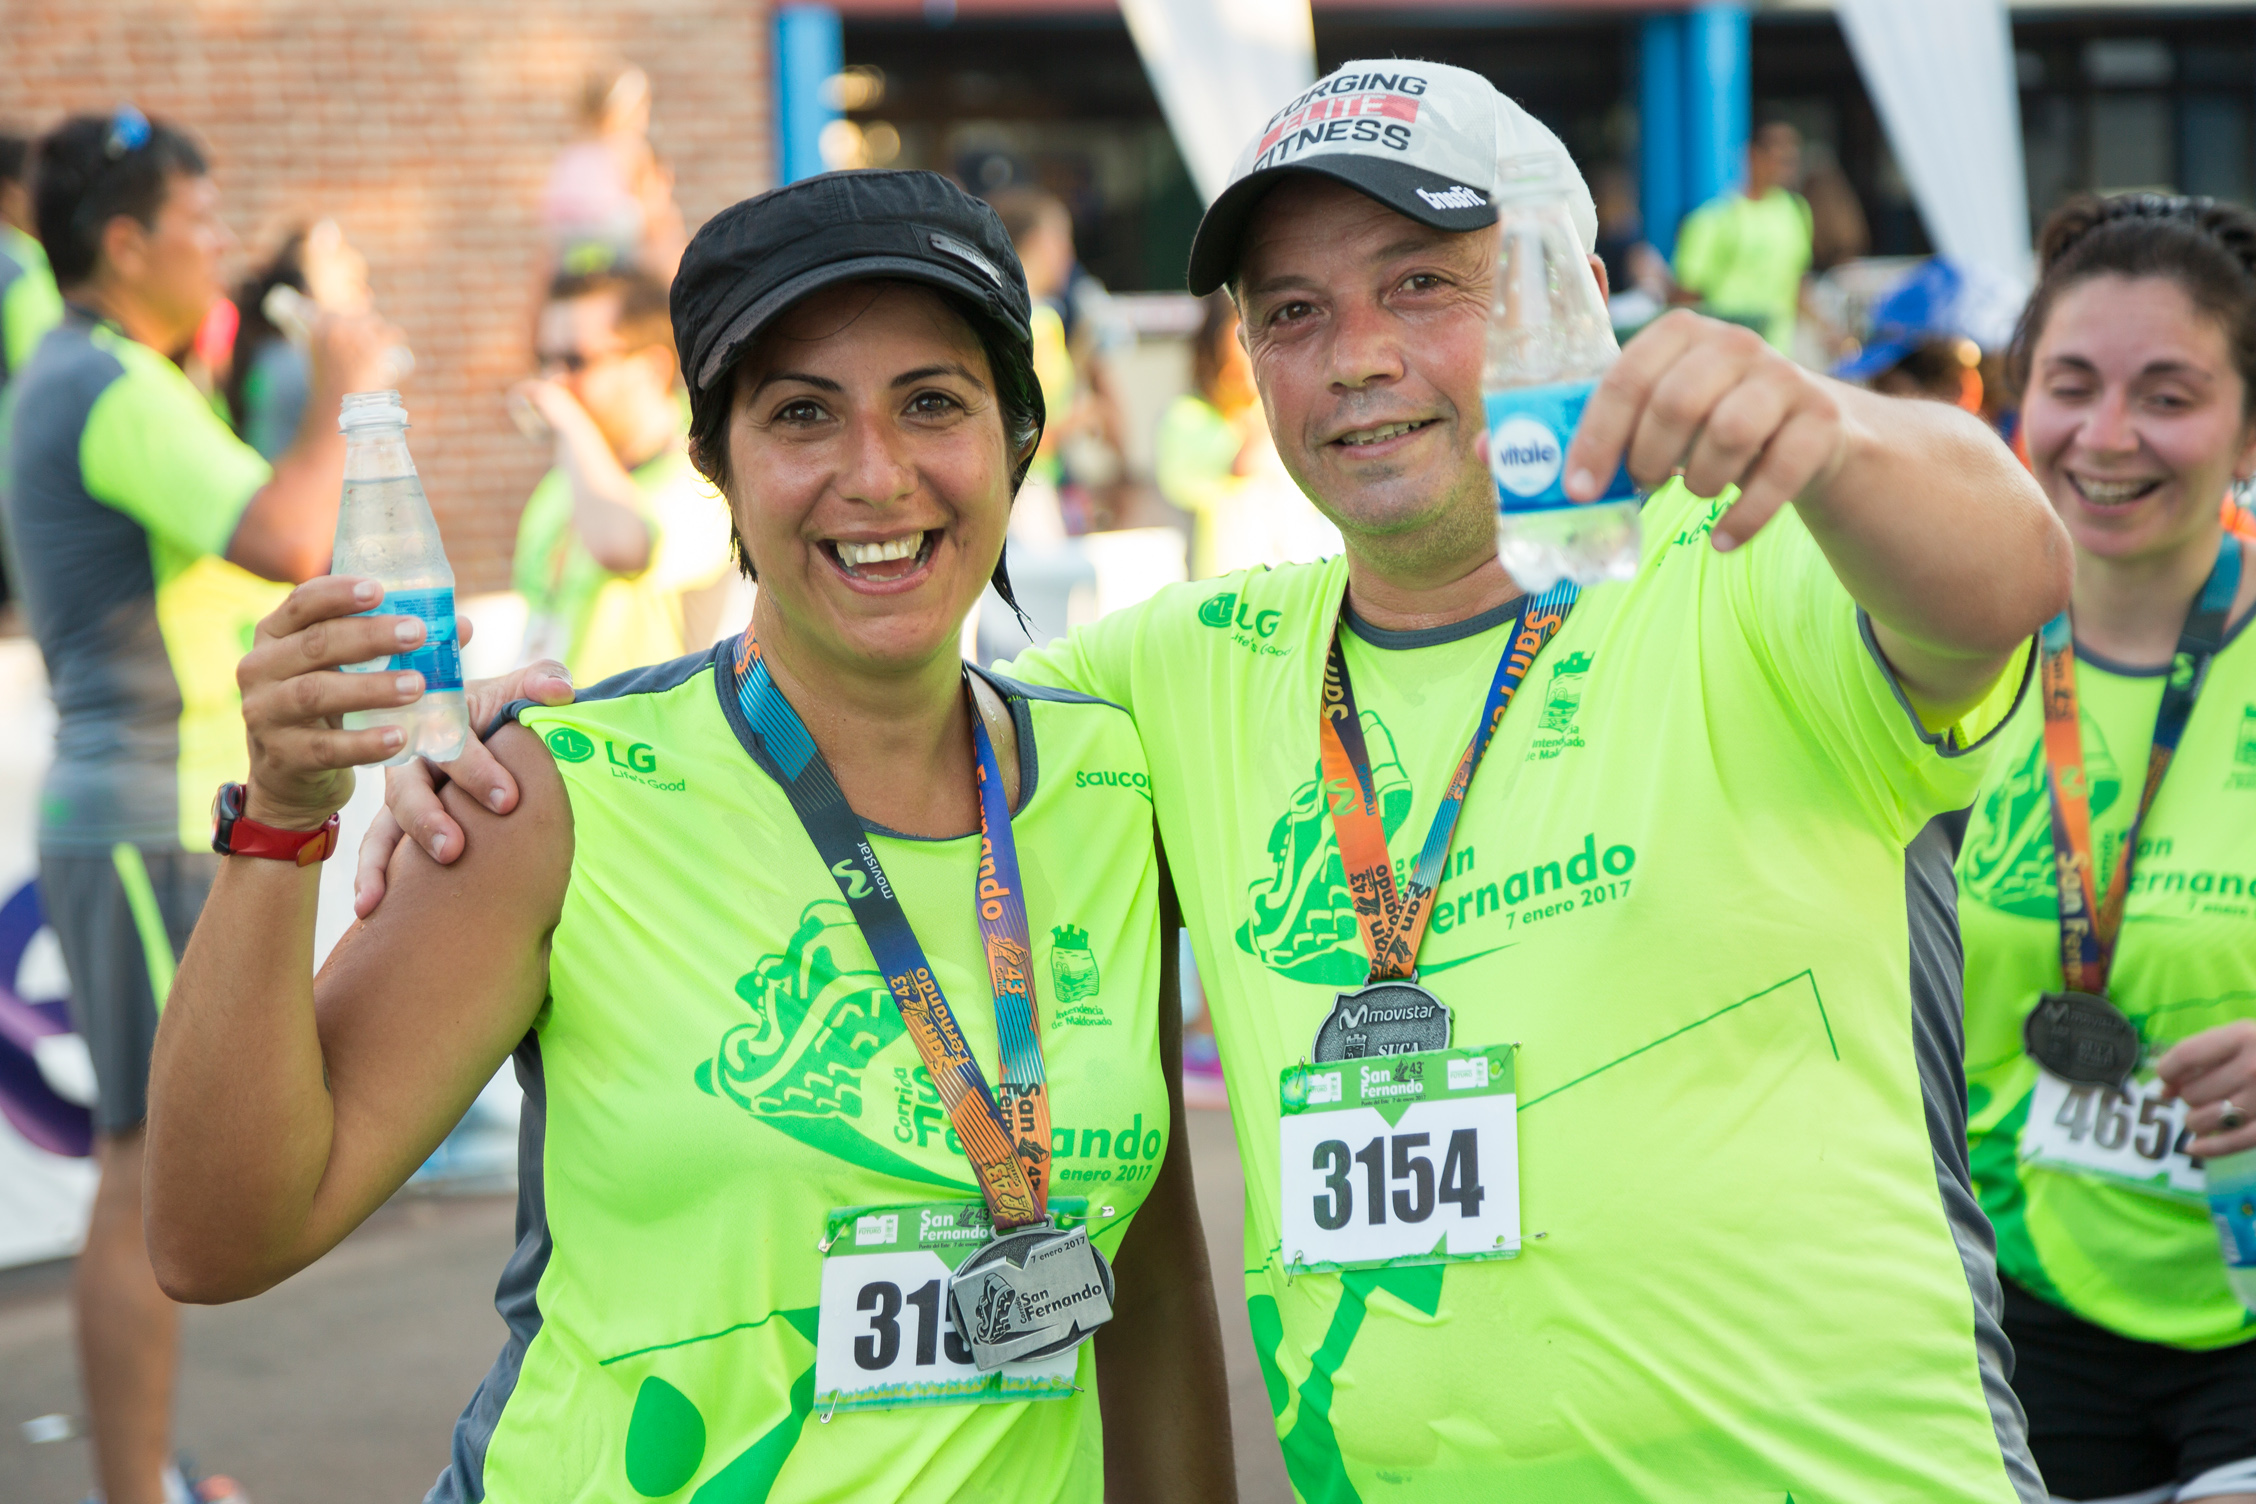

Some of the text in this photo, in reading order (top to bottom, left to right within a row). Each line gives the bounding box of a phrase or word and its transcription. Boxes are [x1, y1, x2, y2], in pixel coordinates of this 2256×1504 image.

[1264, 73, 1428, 135] FORGING
[1282, 94, 1383, 132] ELITE
[1253, 119, 1411, 173] FITNESS
[1500, 441, 1555, 466] vitale
[1235, 603, 1283, 638] LG
[1231, 632, 1293, 656] ife's Good
[1506, 611, 1562, 679] San
[605, 740, 657, 773] LG
[611, 767, 686, 792] Life's Good
[1358, 763, 1377, 816] movistar
[857, 841, 893, 899] movistar
[1430, 832, 1636, 936] ernando
[1400, 886, 1432, 932] San
[1506, 879, 1632, 930] 7 enero 2017
[916, 967, 972, 1068] Fernando
[1051, 1015, 1112, 1029] de Maldonado
[1369, 1005, 1436, 1024] movistar
[922, 1023, 951, 1074] San
[1360, 1066, 1391, 1083] San
[1361, 1078, 1423, 1098] Fernando
[893, 1066, 914, 1144] Corrida
[1017, 1082, 1041, 1132] San
[912, 1104, 1161, 1160] Feando
[1060, 1168, 1110, 1182] enero
[1114, 1164, 1153, 1182] 2017
[1312, 1127, 1485, 1232] 3154
[919, 1225, 989, 1241] Fernando
[920, 1209, 954, 1228] San
[1031, 1236, 1086, 1264] 7 enero 2017
[1015, 1296, 1027, 1324] Corrida
[1021, 1289, 1049, 1306] San
[1024, 1283, 1102, 1322] Fernando
